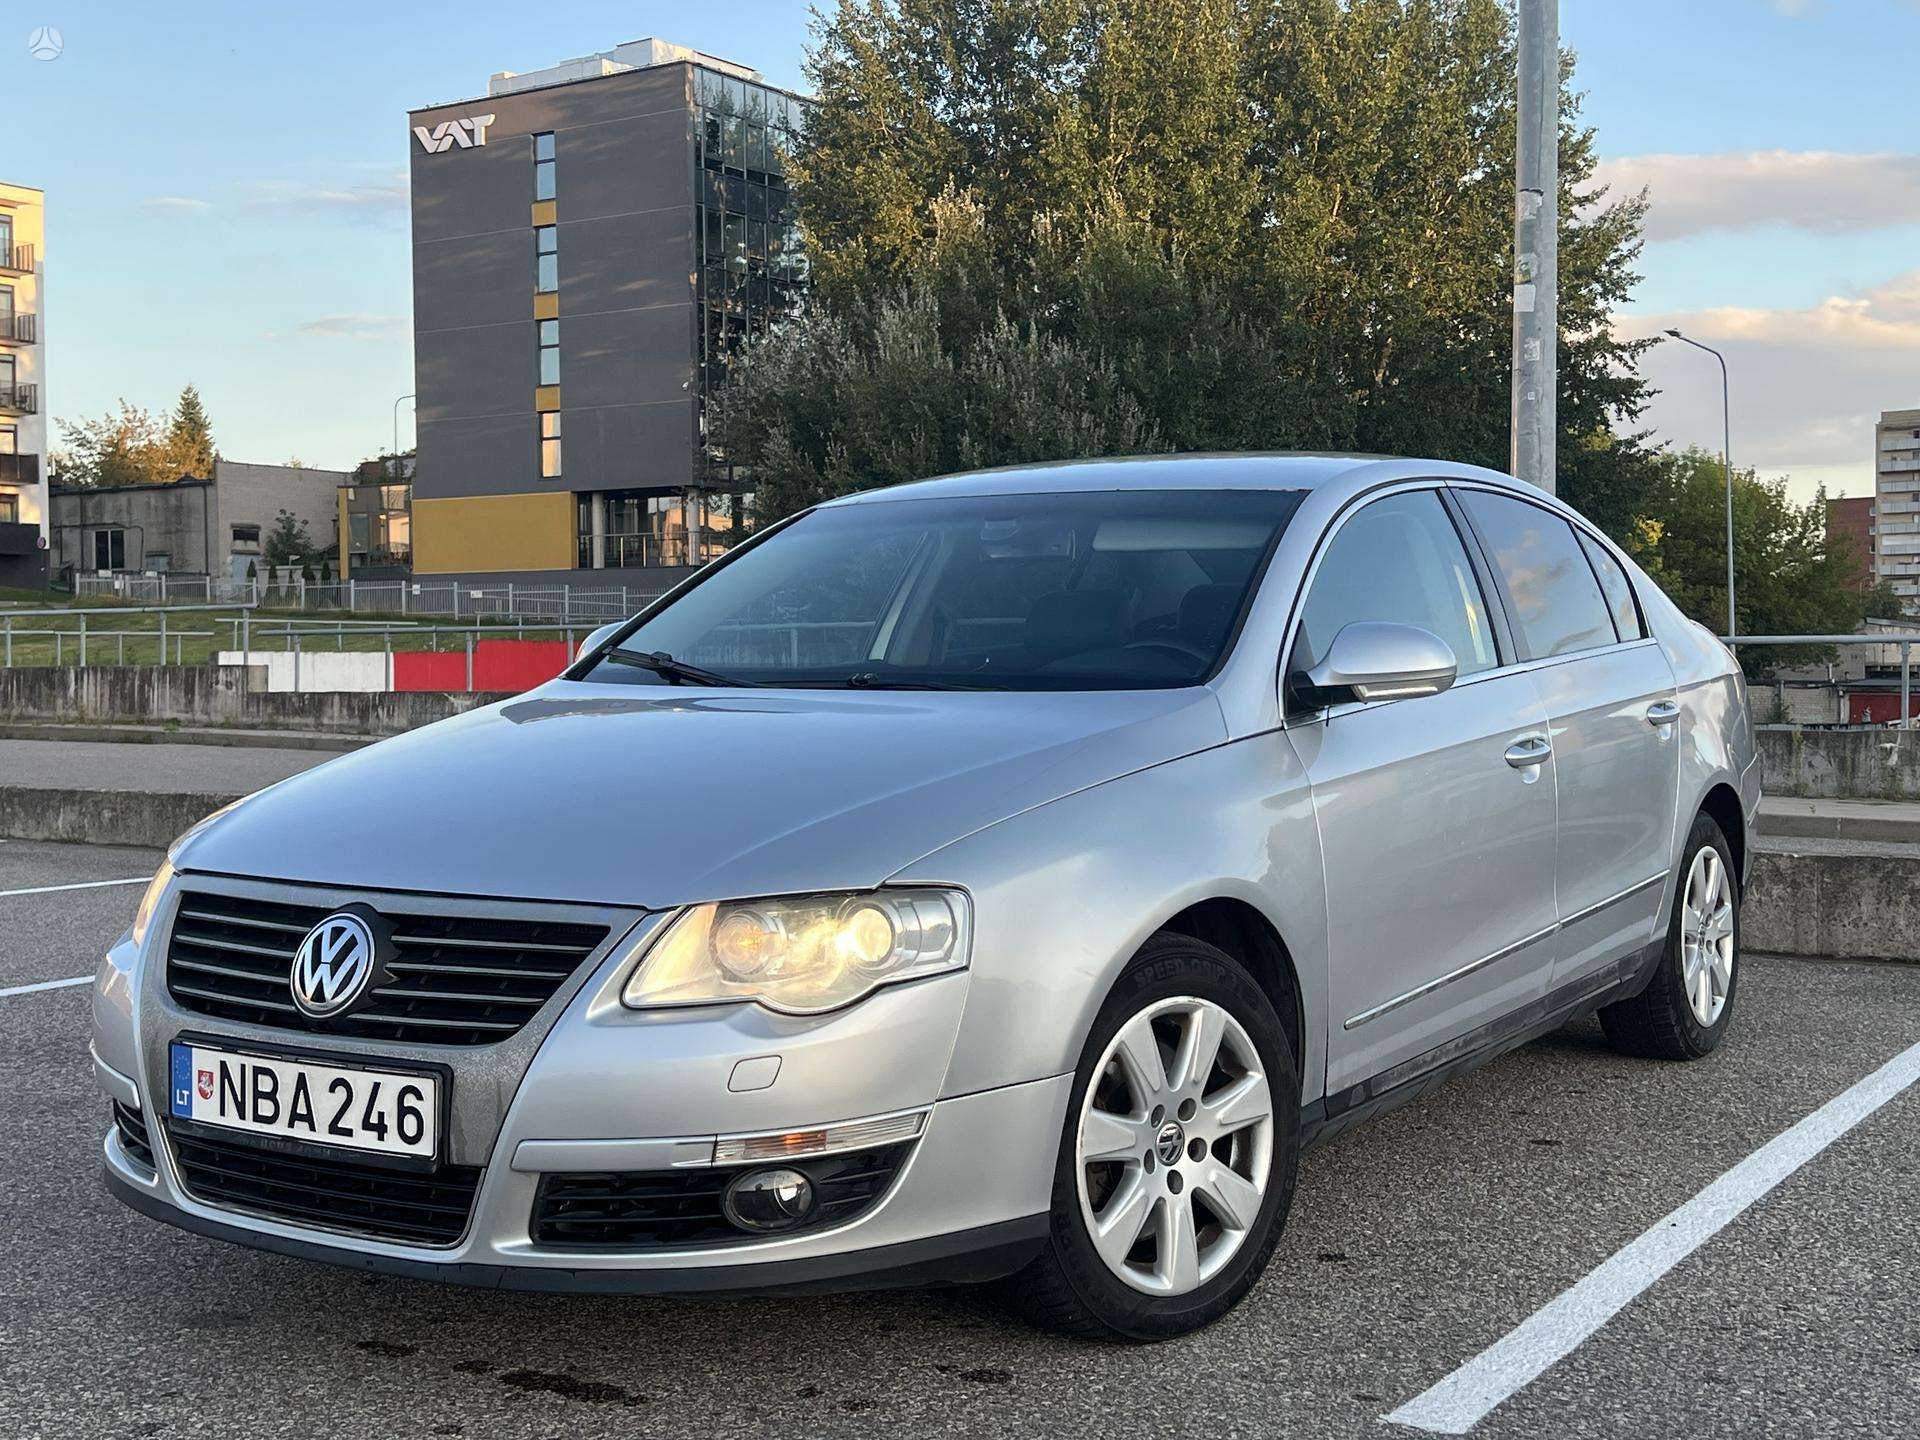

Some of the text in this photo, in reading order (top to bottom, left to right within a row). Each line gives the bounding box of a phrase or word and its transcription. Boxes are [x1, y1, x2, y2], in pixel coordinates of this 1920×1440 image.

[413, 112, 496, 154] VAT
[296, 917, 368, 1011] VW
[176, 1088, 190, 1106] LT
[219, 1059, 425, 1146] NBA246
